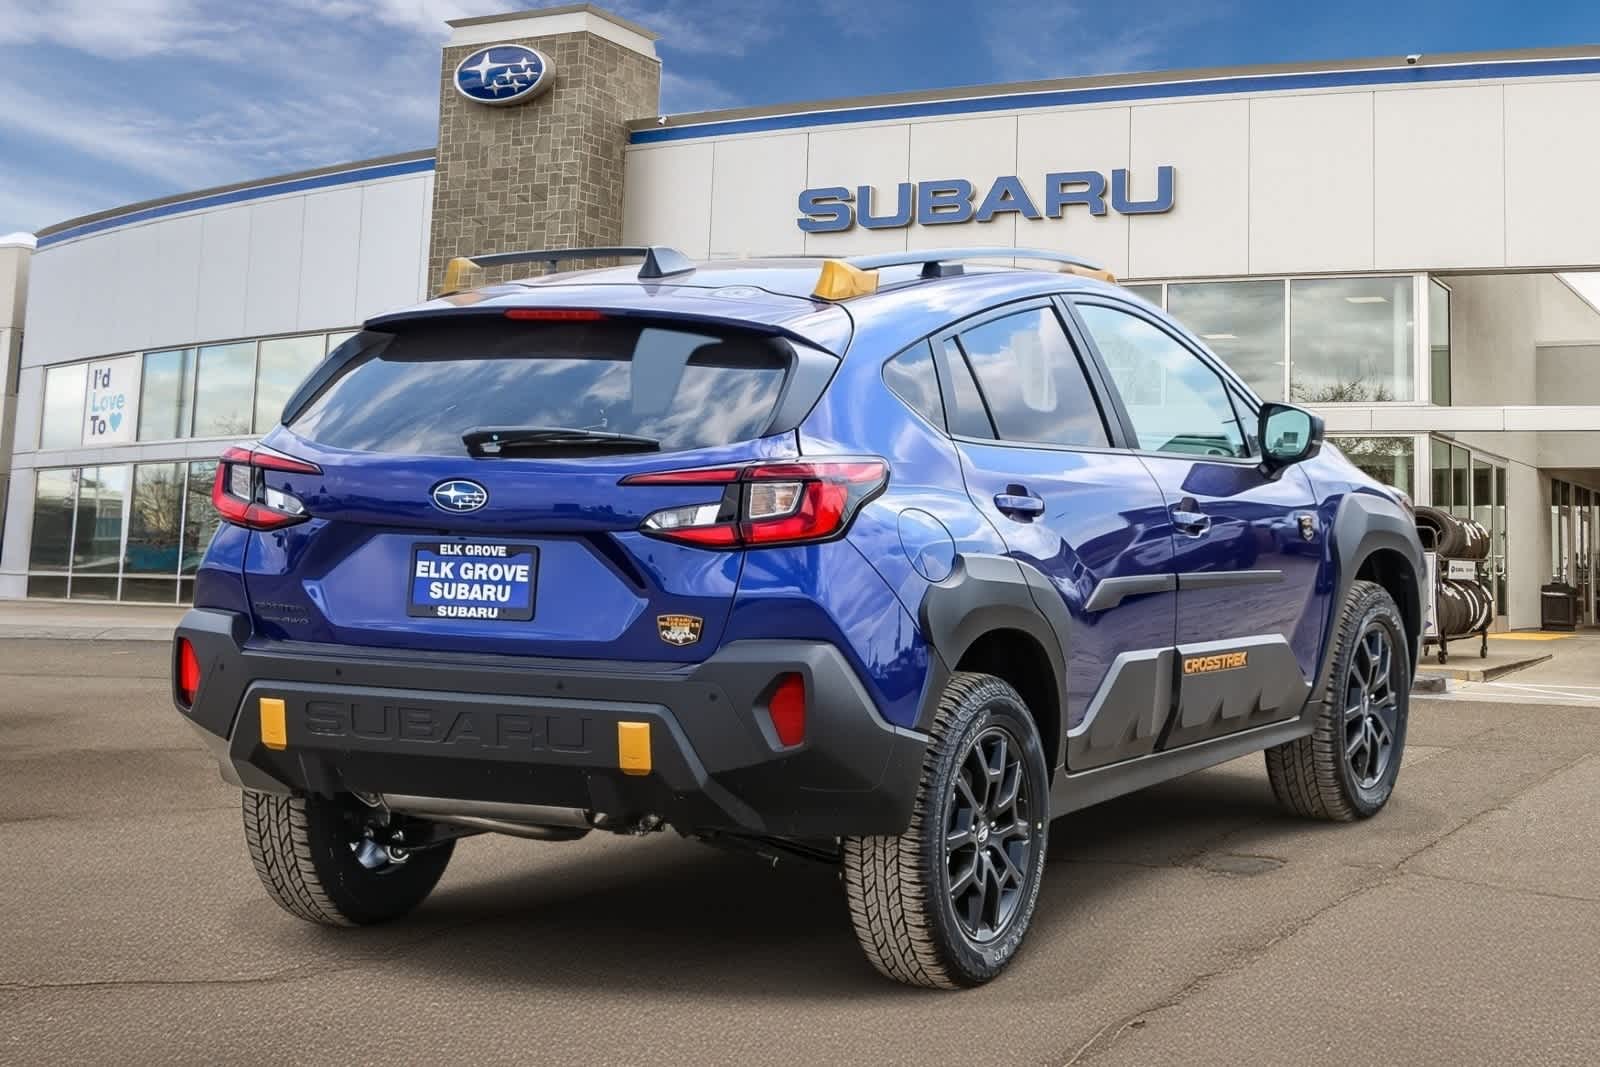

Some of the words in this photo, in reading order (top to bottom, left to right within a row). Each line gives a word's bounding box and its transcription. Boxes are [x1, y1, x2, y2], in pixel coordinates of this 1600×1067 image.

[797, 165, 1174, 233] SUBARU
[94, 368, 111, 389] I'd
[92, 392, 125, 412] Love
[90, 415, 106, 435] To
[440, 544, 462, 556] ELK
[465, 545, 507, 557] GROVE
[416, 560, 455, 579] ELK
[459, 562, 529, 582] GROVE
[429, 581, 511, 602] SUBARU
[437, 605, 498, 618] SUBARU
[1184, 651, 1248, 674] CROSSTREK
[305, 701, 593, 754] SUBARU
